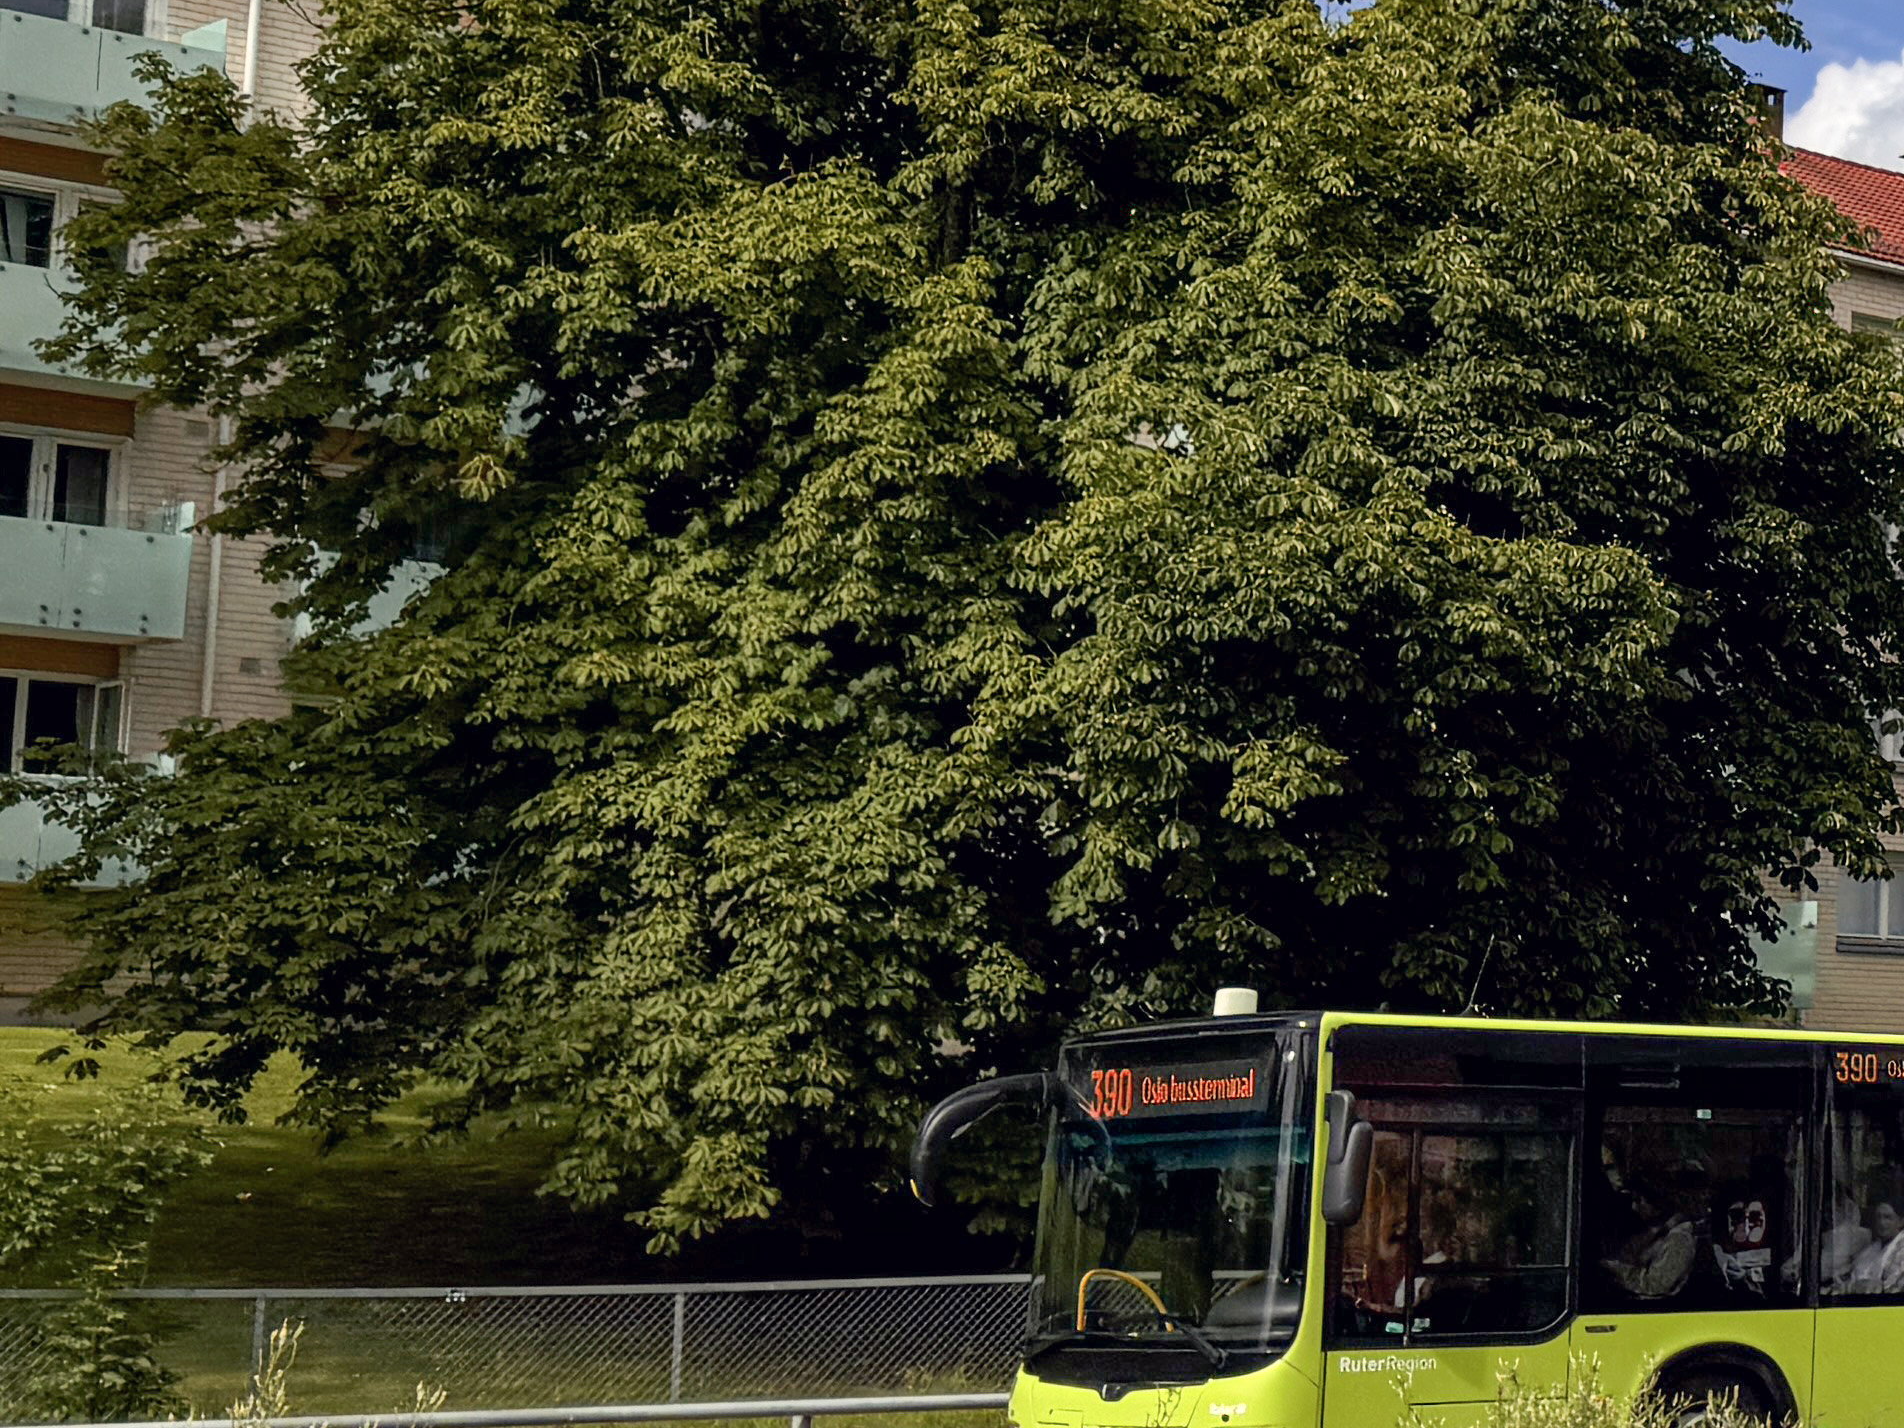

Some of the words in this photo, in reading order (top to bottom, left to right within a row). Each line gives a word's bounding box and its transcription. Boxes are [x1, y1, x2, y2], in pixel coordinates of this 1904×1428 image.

[1836, 1052, 1878, 1083] 390
[1091, 1068, 1132, 1120] 390
[1142, 1076, 1168, 1104] Oslo
[1170, 1068, 1254, 1103] bussterminal
